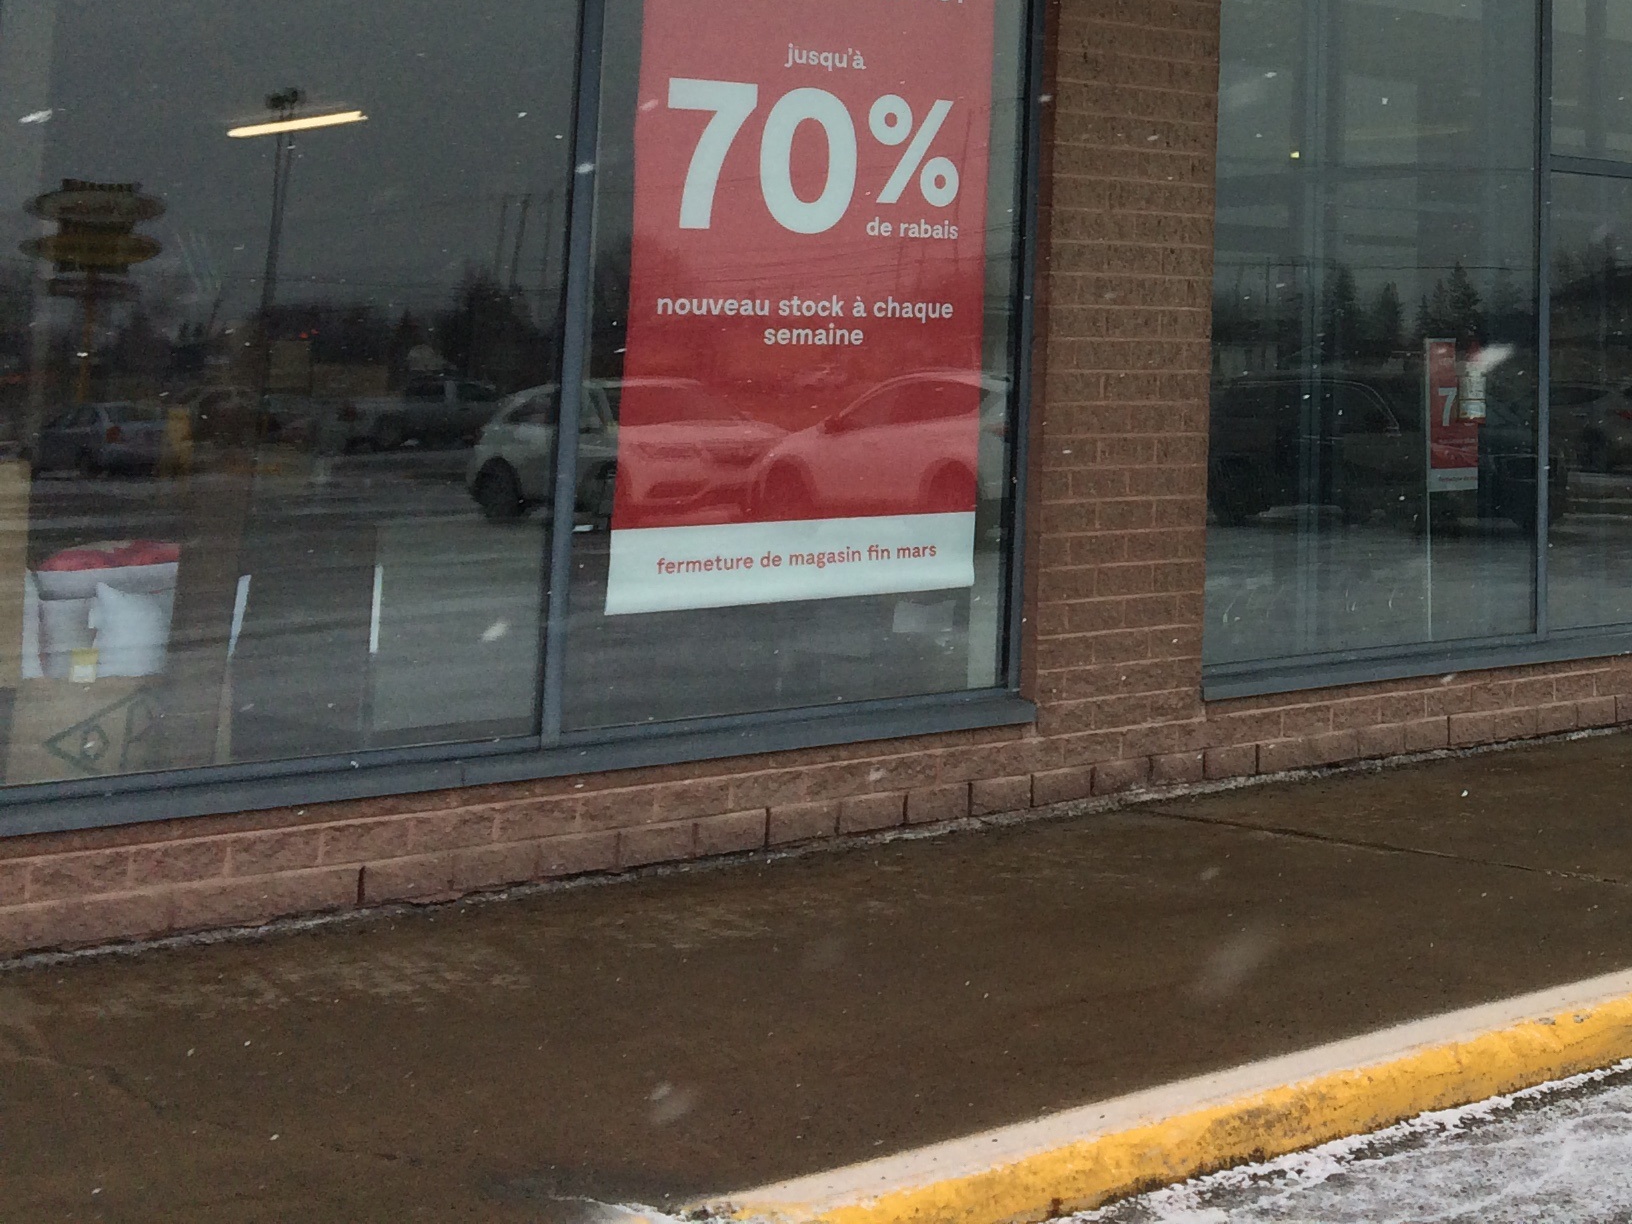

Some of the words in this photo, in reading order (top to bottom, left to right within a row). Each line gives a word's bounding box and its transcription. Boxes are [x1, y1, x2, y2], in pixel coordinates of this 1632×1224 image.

[785, 43, 866, 71] jusqu'à
[668, 77, 959, 234] 70%
[866, 217, 892, 236] de
[899, 218, 959, 239] rabais
[656, 296, 770, 316] nouveau
[778, 295, 844, 317] stock
[852, 295, 867, 317] à
[873, 295, 954, 323] chaque
[763, 323, 864, 345] semaine
[656, 557, 754, 575] fermeture
[760, 551, 782, 568] de
[788, 546, 862, 568] magasin
[867, 544, 891, 561] fin
[896, 543, 937, 559] mars
